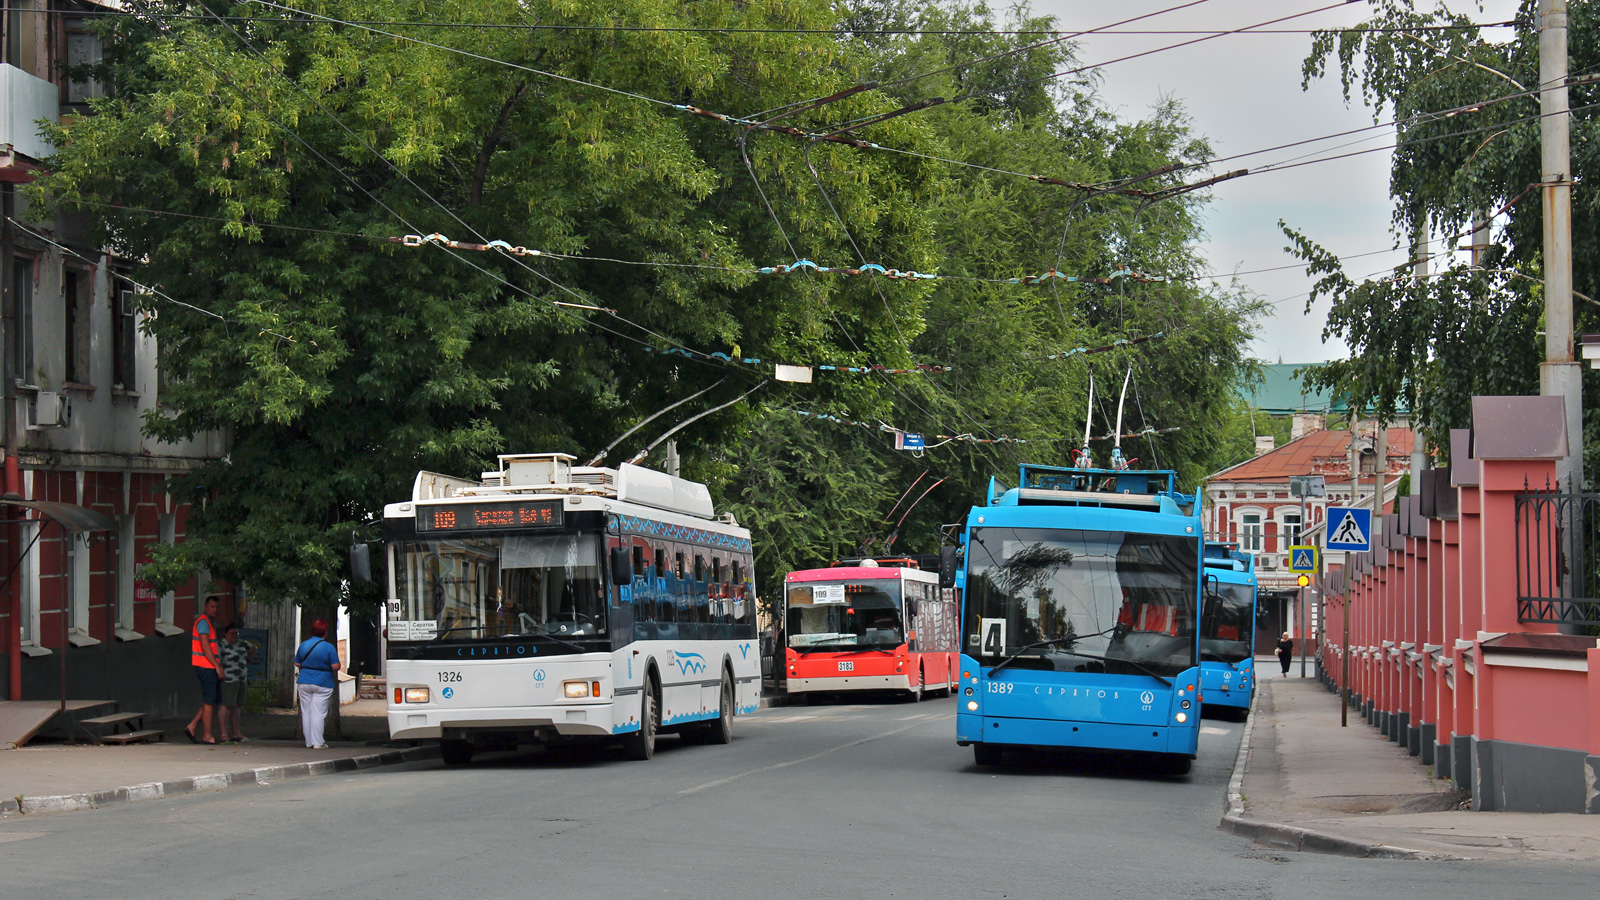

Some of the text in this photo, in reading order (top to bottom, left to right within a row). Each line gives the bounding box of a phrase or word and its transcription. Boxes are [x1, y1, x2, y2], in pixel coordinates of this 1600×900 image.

[434, 511, 455, 528] 109
[815, 590, 827, 598] 109
[985, 623, 1003, 657] 4
[457, 645, 537, 656] САРАТОВ
[839, 662, 853, 670] 3183
[437, 671, 463, 683] 1326
[987, 682, 1014, 694] 1389
[1034, 686, 1119, 699] САРАТОВ
